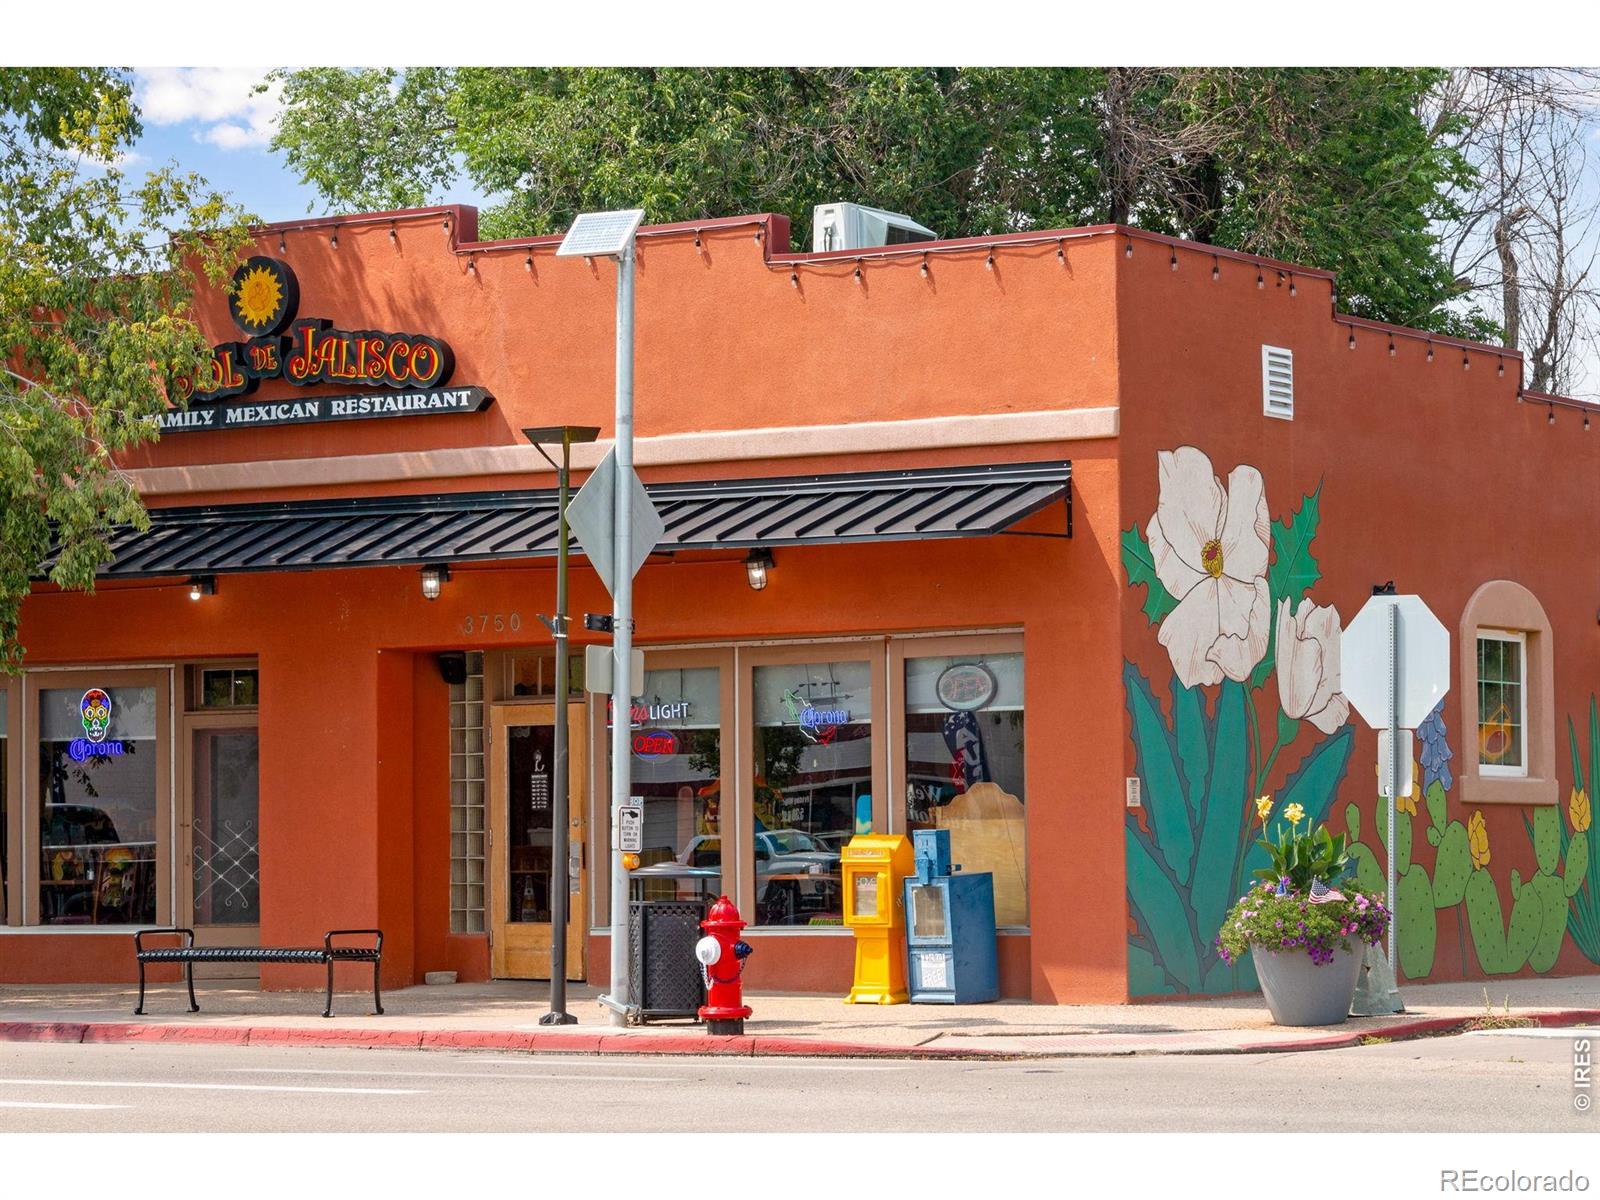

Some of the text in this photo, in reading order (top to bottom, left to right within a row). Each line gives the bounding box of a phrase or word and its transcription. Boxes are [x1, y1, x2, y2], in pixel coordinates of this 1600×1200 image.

[251, 345, 278, 371] DE
[291, 326, 439, 381] JALISCO
[225, 401, 320, 424] MEXICAN
[331, 390, 471, 415] RESTAURANT
[463, 612, 521, 634] 3750
[649, 702, 689, 720] LIGHT
[799, 707, 849, 728] Corona
[69, 738, 123, 762] Corona
[633, 735, 675, 754] OPEN
